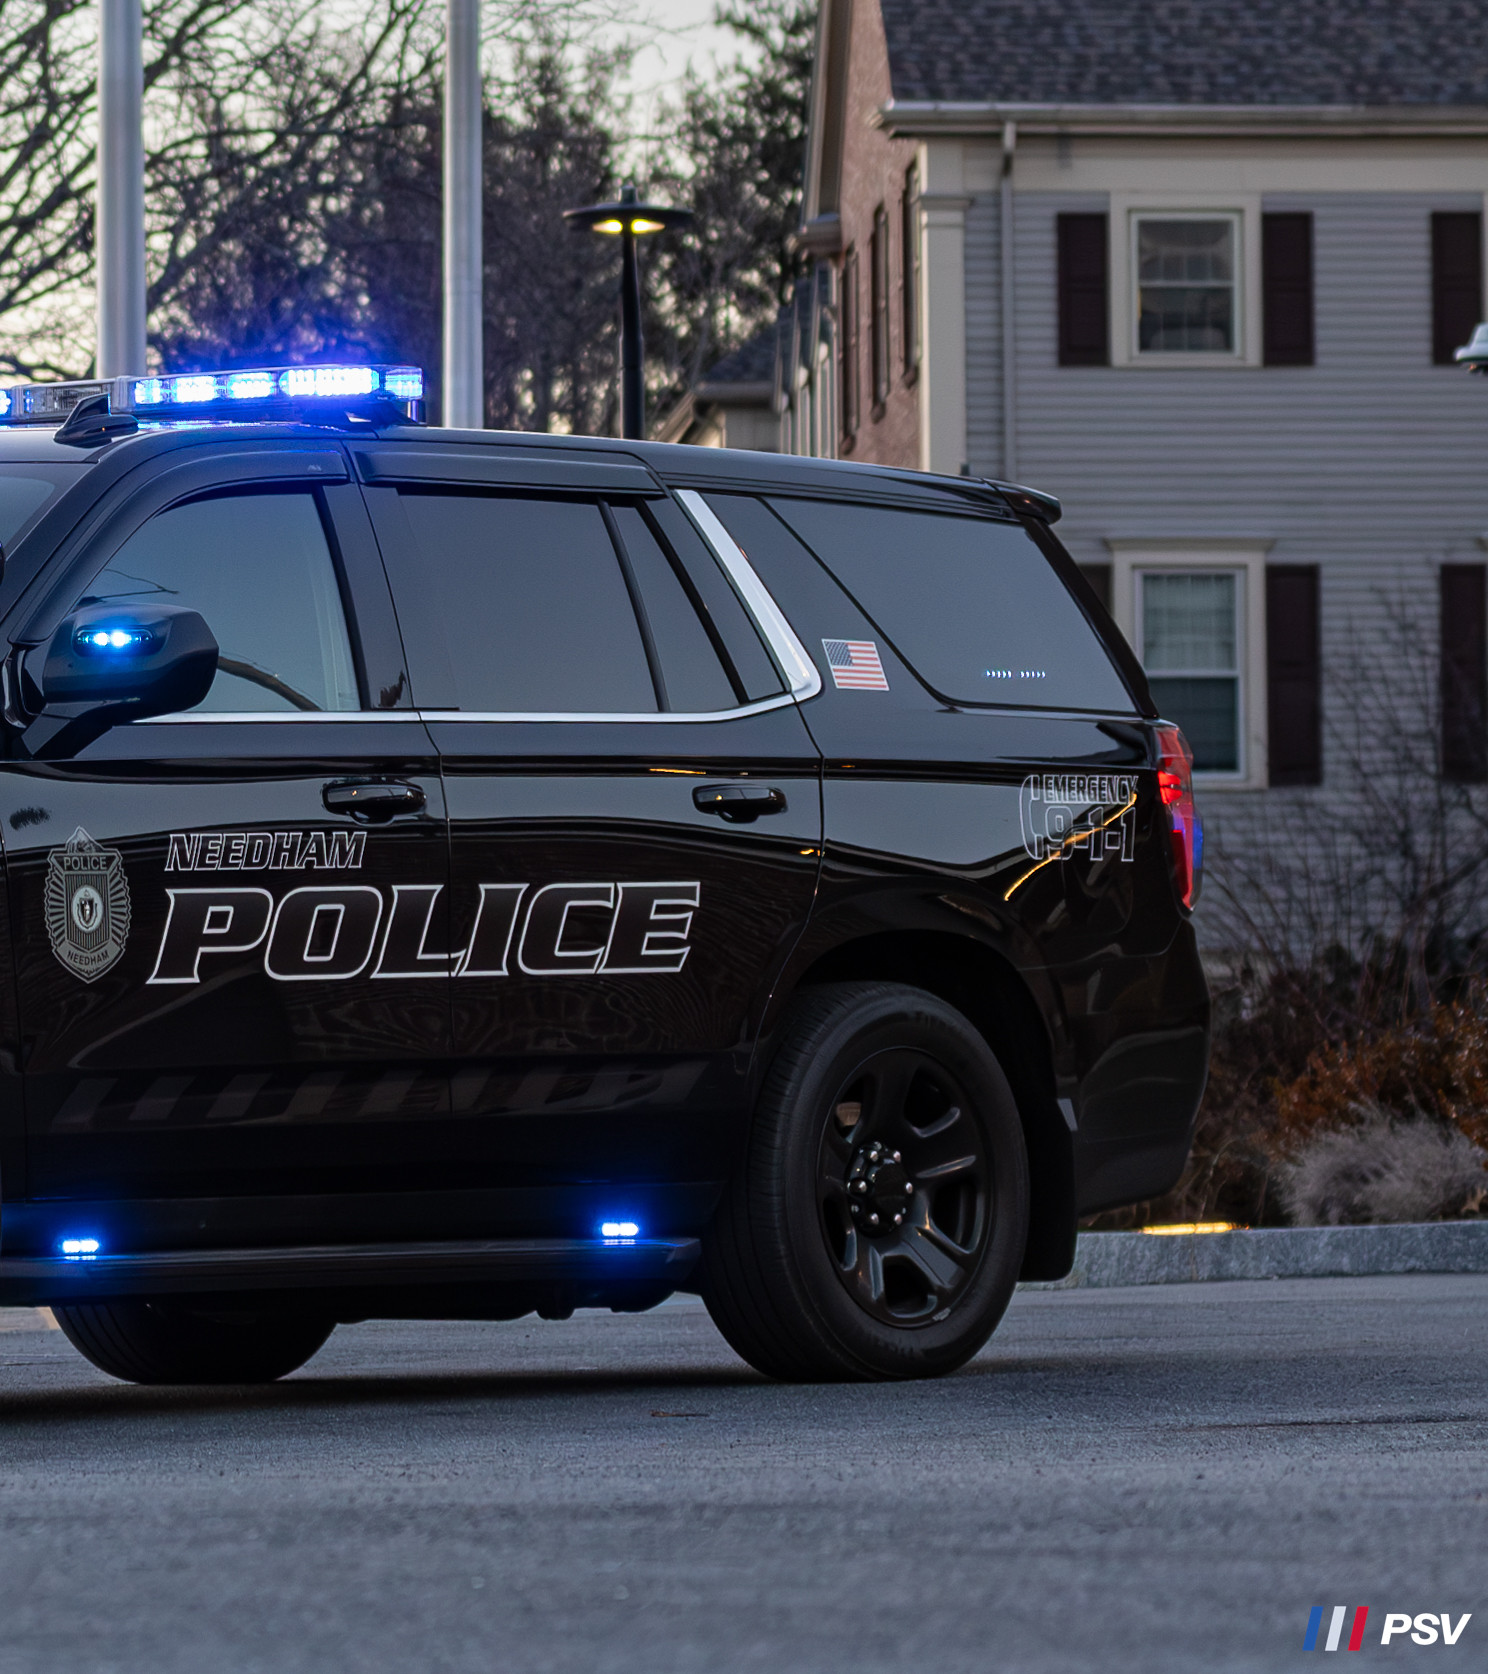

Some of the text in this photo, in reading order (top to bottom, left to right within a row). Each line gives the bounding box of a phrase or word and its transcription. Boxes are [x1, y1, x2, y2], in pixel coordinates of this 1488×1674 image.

[1042, 774, 1139, 805] EMERGENCY
[63, 856, 108, 871] POLICE
[164, 830, 368, 873] NEEDHAM
[145, 880, 701, 985] POLICE
[66, 949, 110, 966] NEEDHAM
